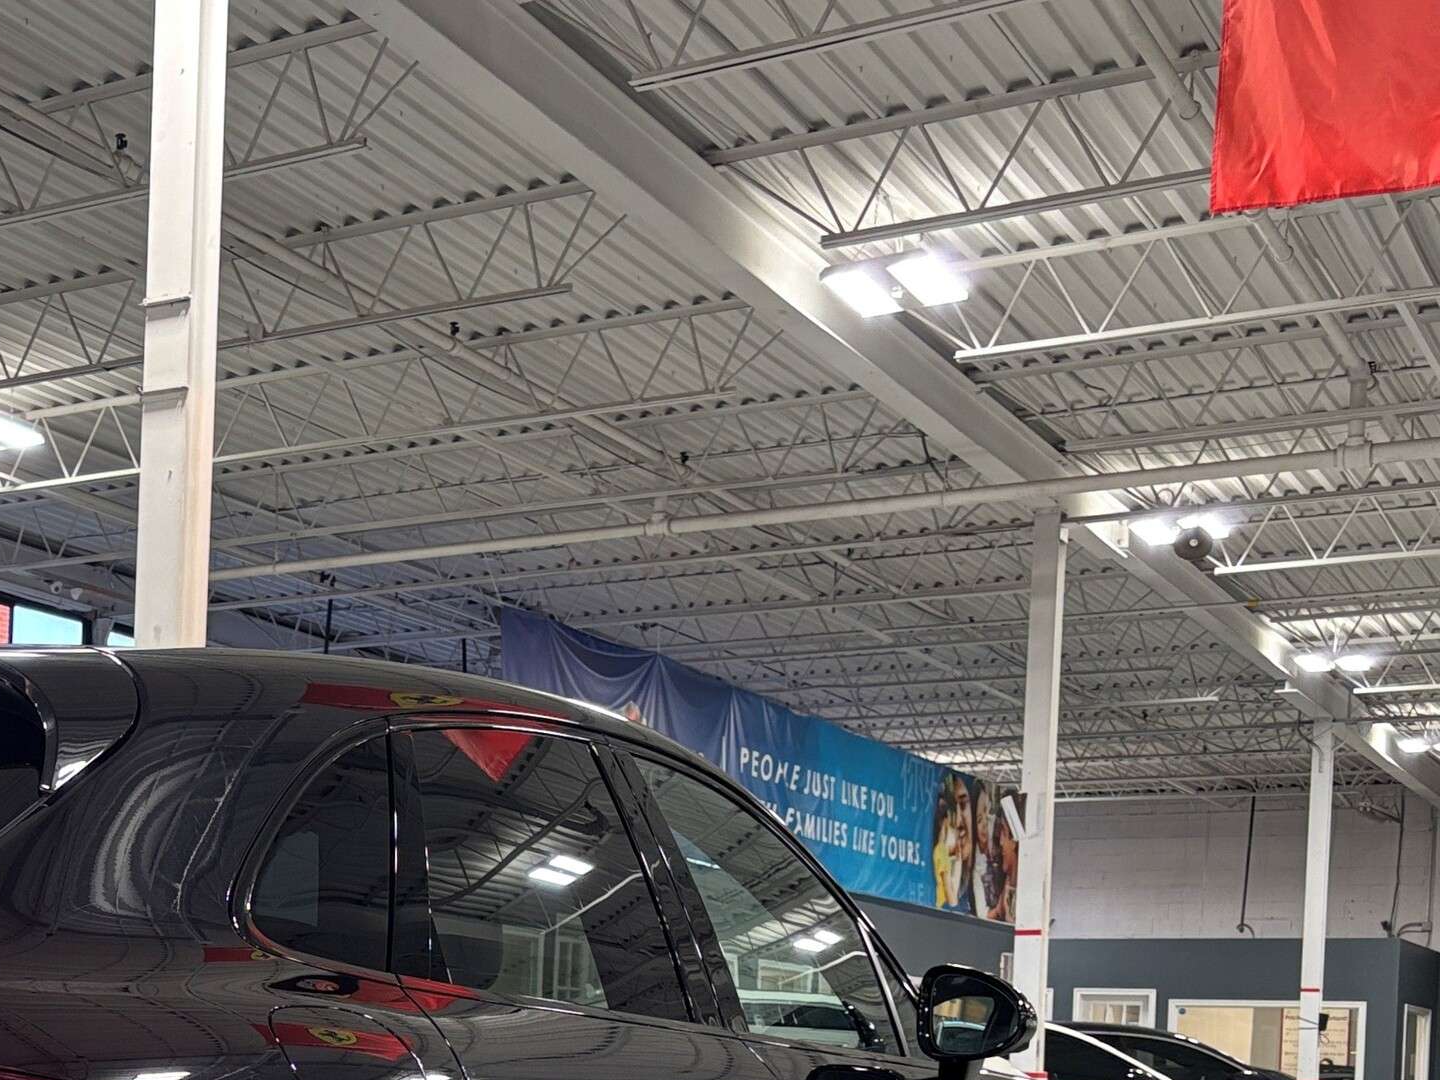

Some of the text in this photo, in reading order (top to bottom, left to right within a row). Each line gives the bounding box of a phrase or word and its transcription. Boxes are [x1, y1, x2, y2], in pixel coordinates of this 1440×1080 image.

[803, 769, 836, 801] JUST
[841, 780, 867, 810] LIKE
[871, 789, 898, 823] YOU,
[785, 807, 926, 867] FAMILIES LIKE YOURS.
